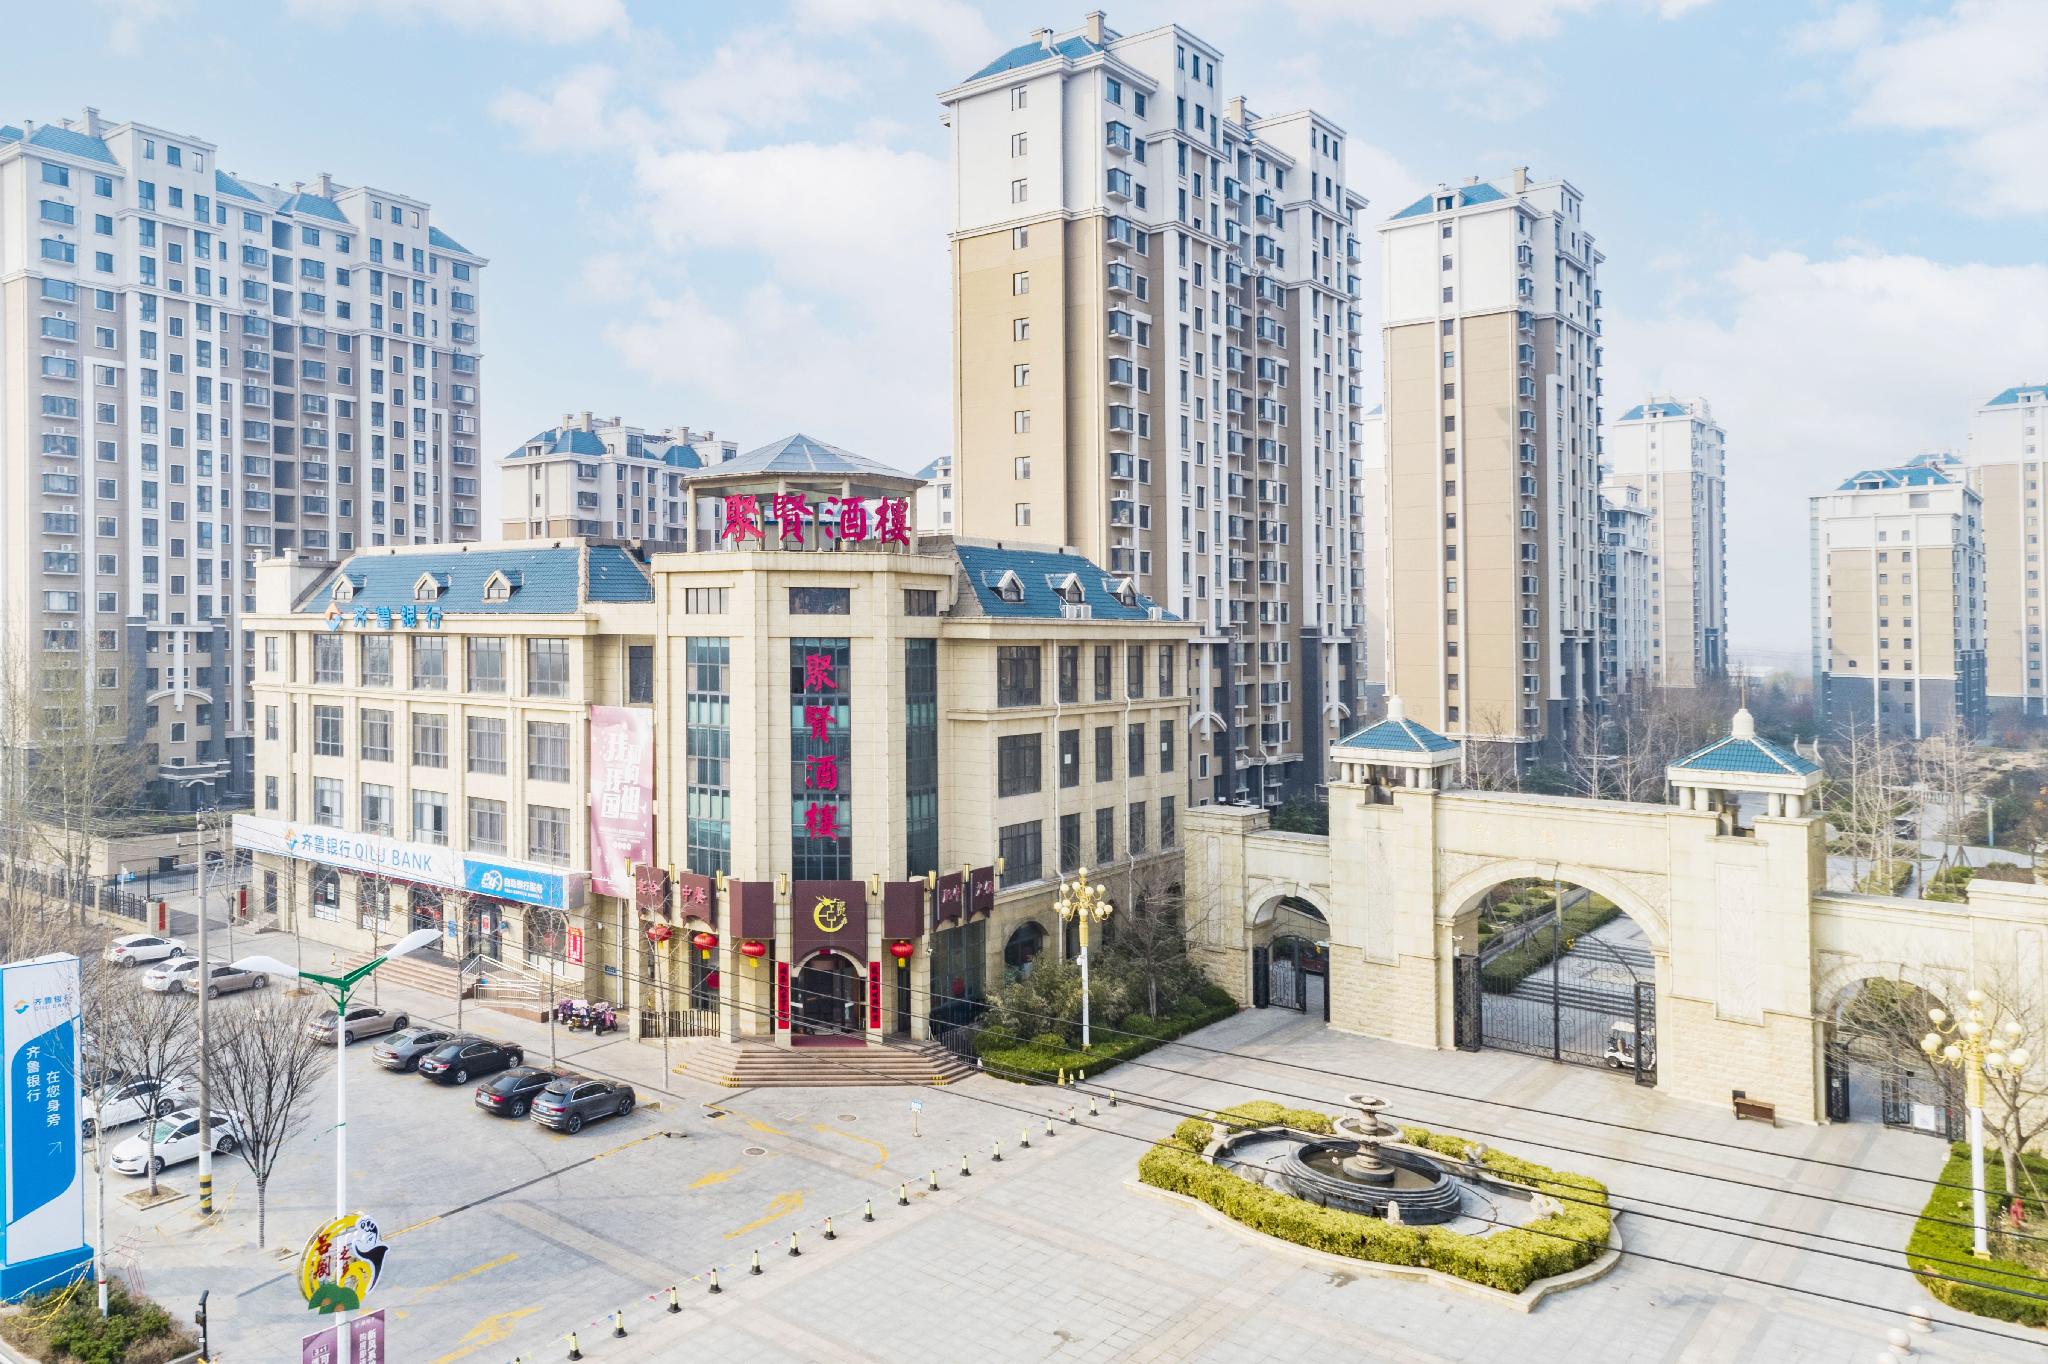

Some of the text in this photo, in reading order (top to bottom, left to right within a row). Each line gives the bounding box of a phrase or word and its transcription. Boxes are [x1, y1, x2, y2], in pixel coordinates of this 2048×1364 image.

[722, 493, 912, 545] 聚賢酒樓
[353, 605, 442, 629] 齐鲁银行
[804, 654, 838, 841] 聚賢酒樓
[302, 833, 350, 858] 齐鲁银行
[392, 849, 432, 872] BANK
[26, 1046, 41, 1103] 齐鲁银行
[46, 1071, 61, 1127] 在您身旁
